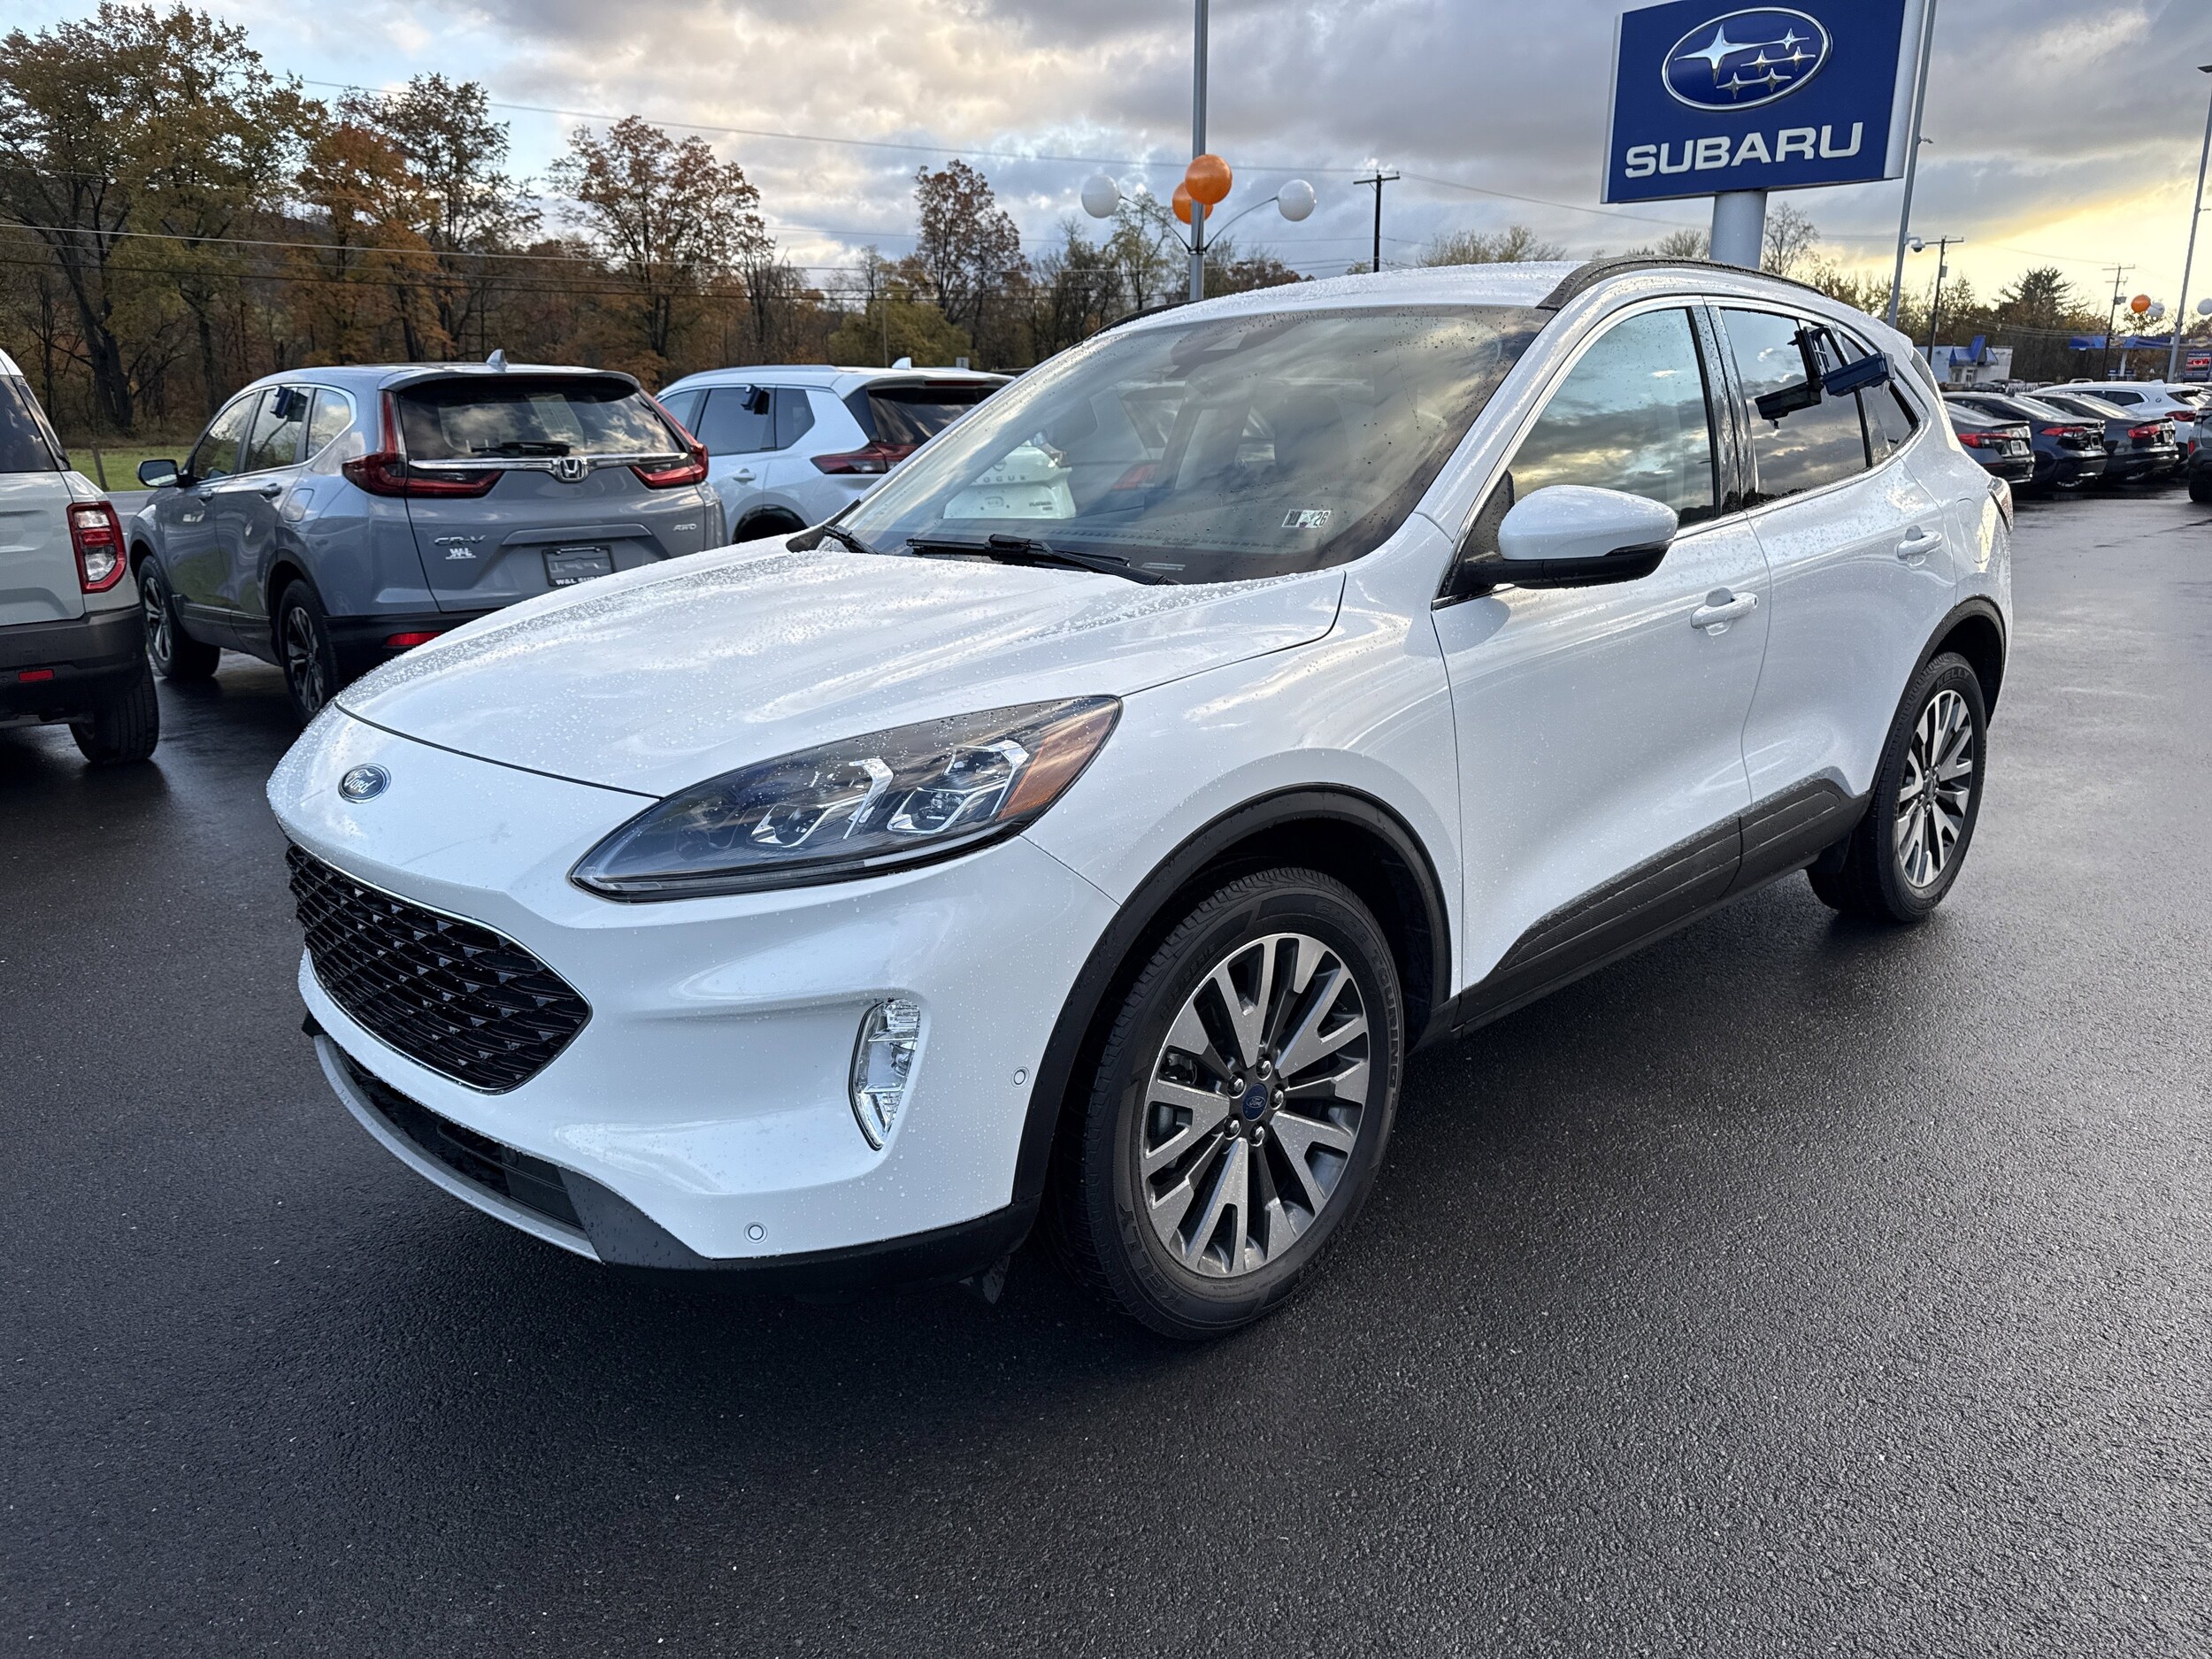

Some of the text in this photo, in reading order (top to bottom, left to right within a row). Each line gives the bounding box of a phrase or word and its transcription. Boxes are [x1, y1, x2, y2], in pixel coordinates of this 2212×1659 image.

[1625, 122, 1863, 178] SUBARU
[1313, 511, 1329, 526] 26
[434, 534, 486, 546] CR-V
[1936, 668, 1970, 689] KELLY
[344, 768, 377, 794] Ford
[1371, 948, 1399, 1089] TOURING
[1248, 1096, 1263, 1106] Ford
[1117, 1202, 1187, 1308] KELLY
